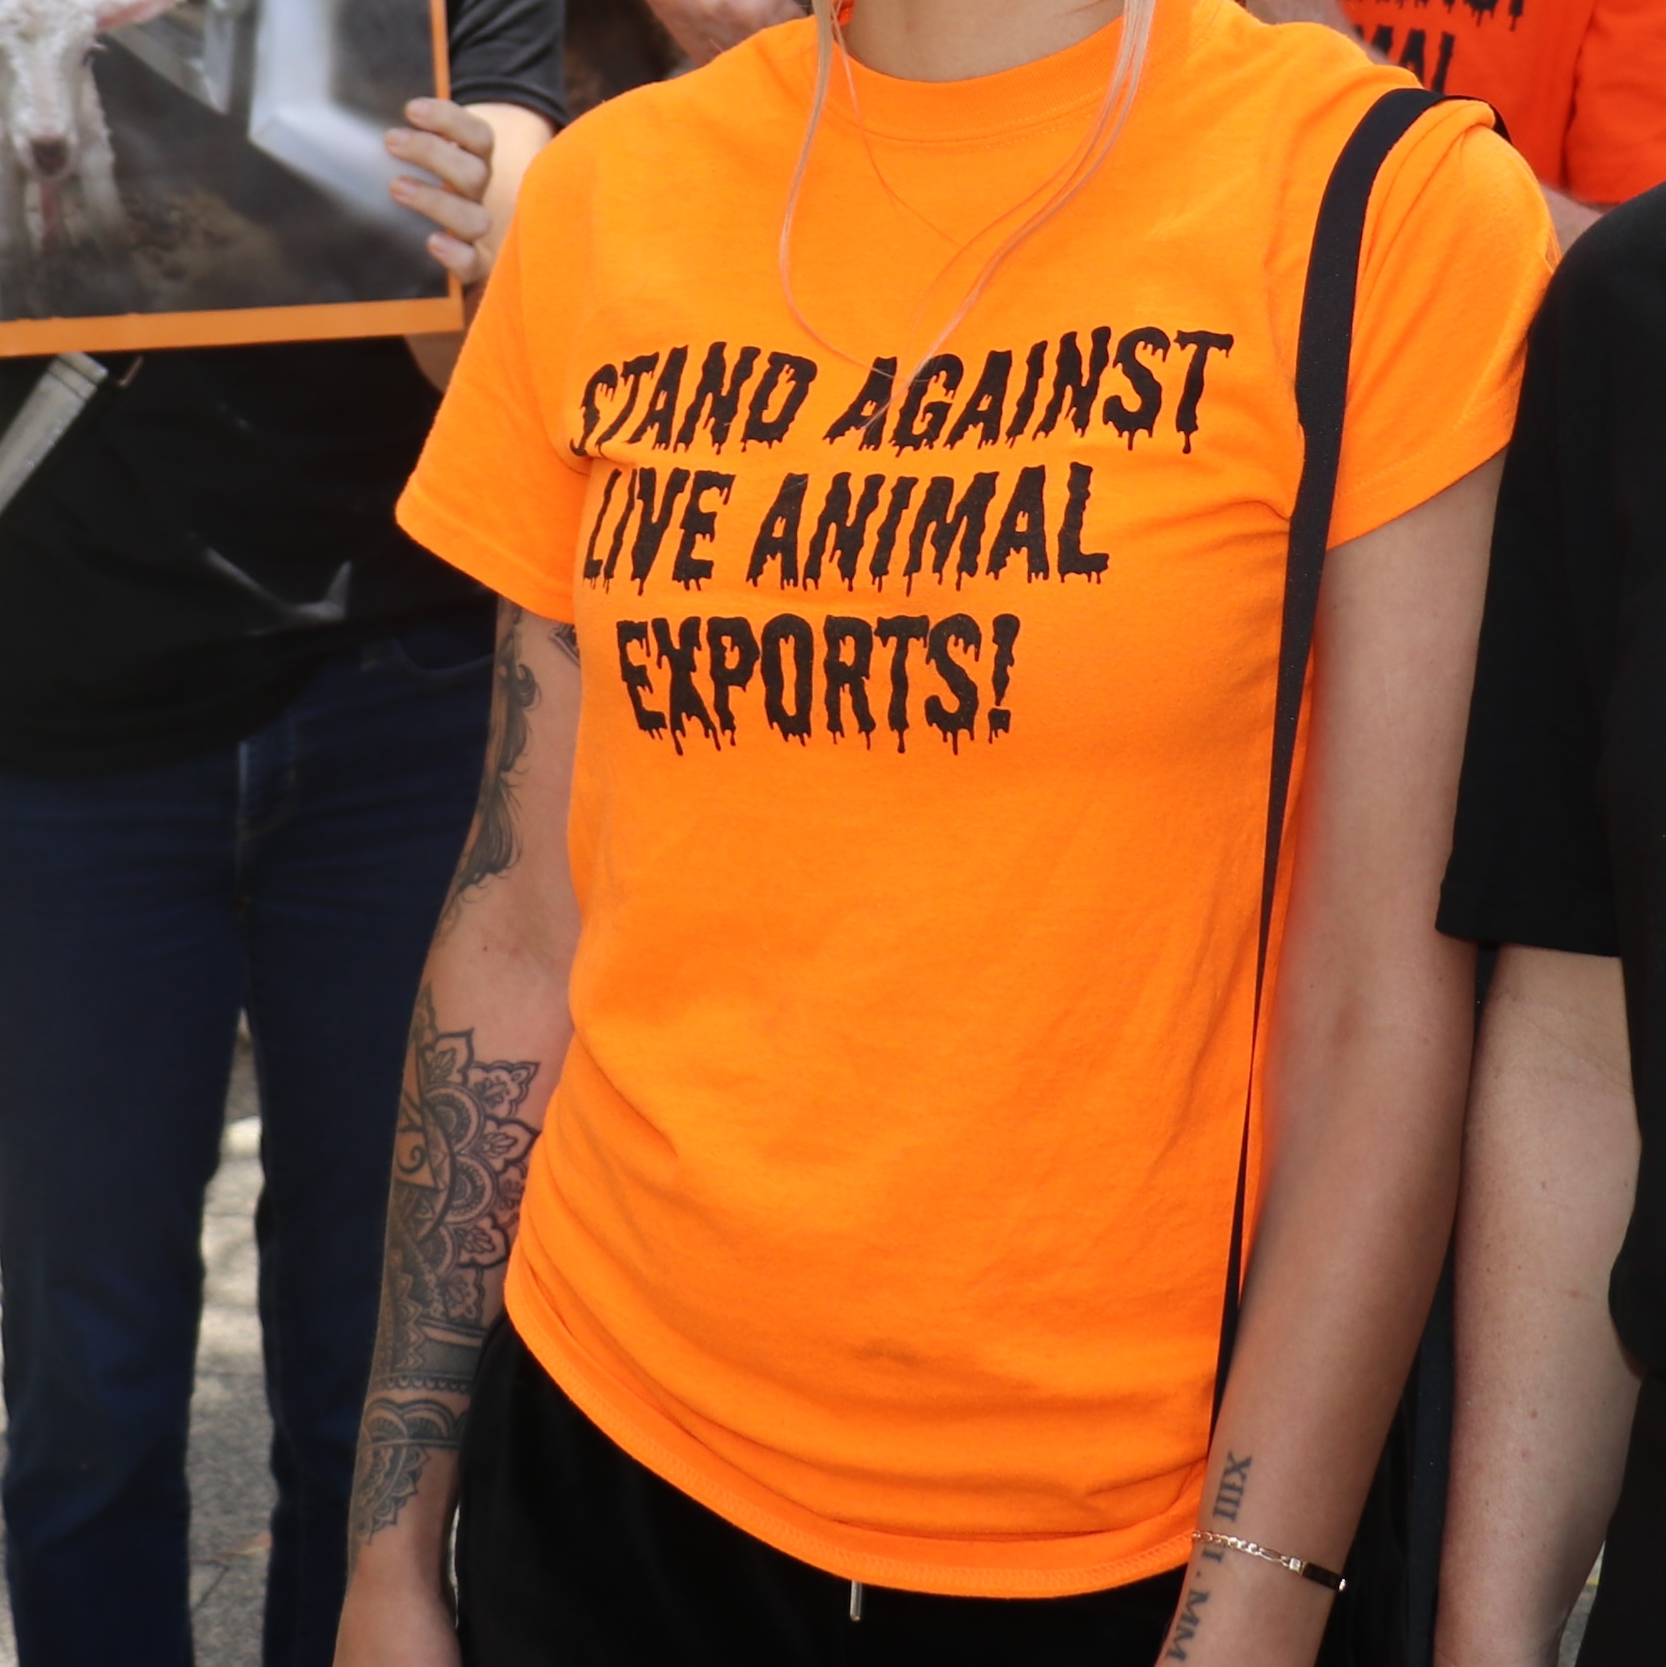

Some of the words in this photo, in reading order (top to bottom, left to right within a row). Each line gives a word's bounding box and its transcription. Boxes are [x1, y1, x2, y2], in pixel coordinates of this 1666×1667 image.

[569, 341, 817, 458] STAND
[824, 325, 1234, 456] AGAINST
[583, 467, 735, 595] LIVE
[747, 461, 1109, 596] ANIMAL
[617, 612, 1021, 756] EXPORTS!
